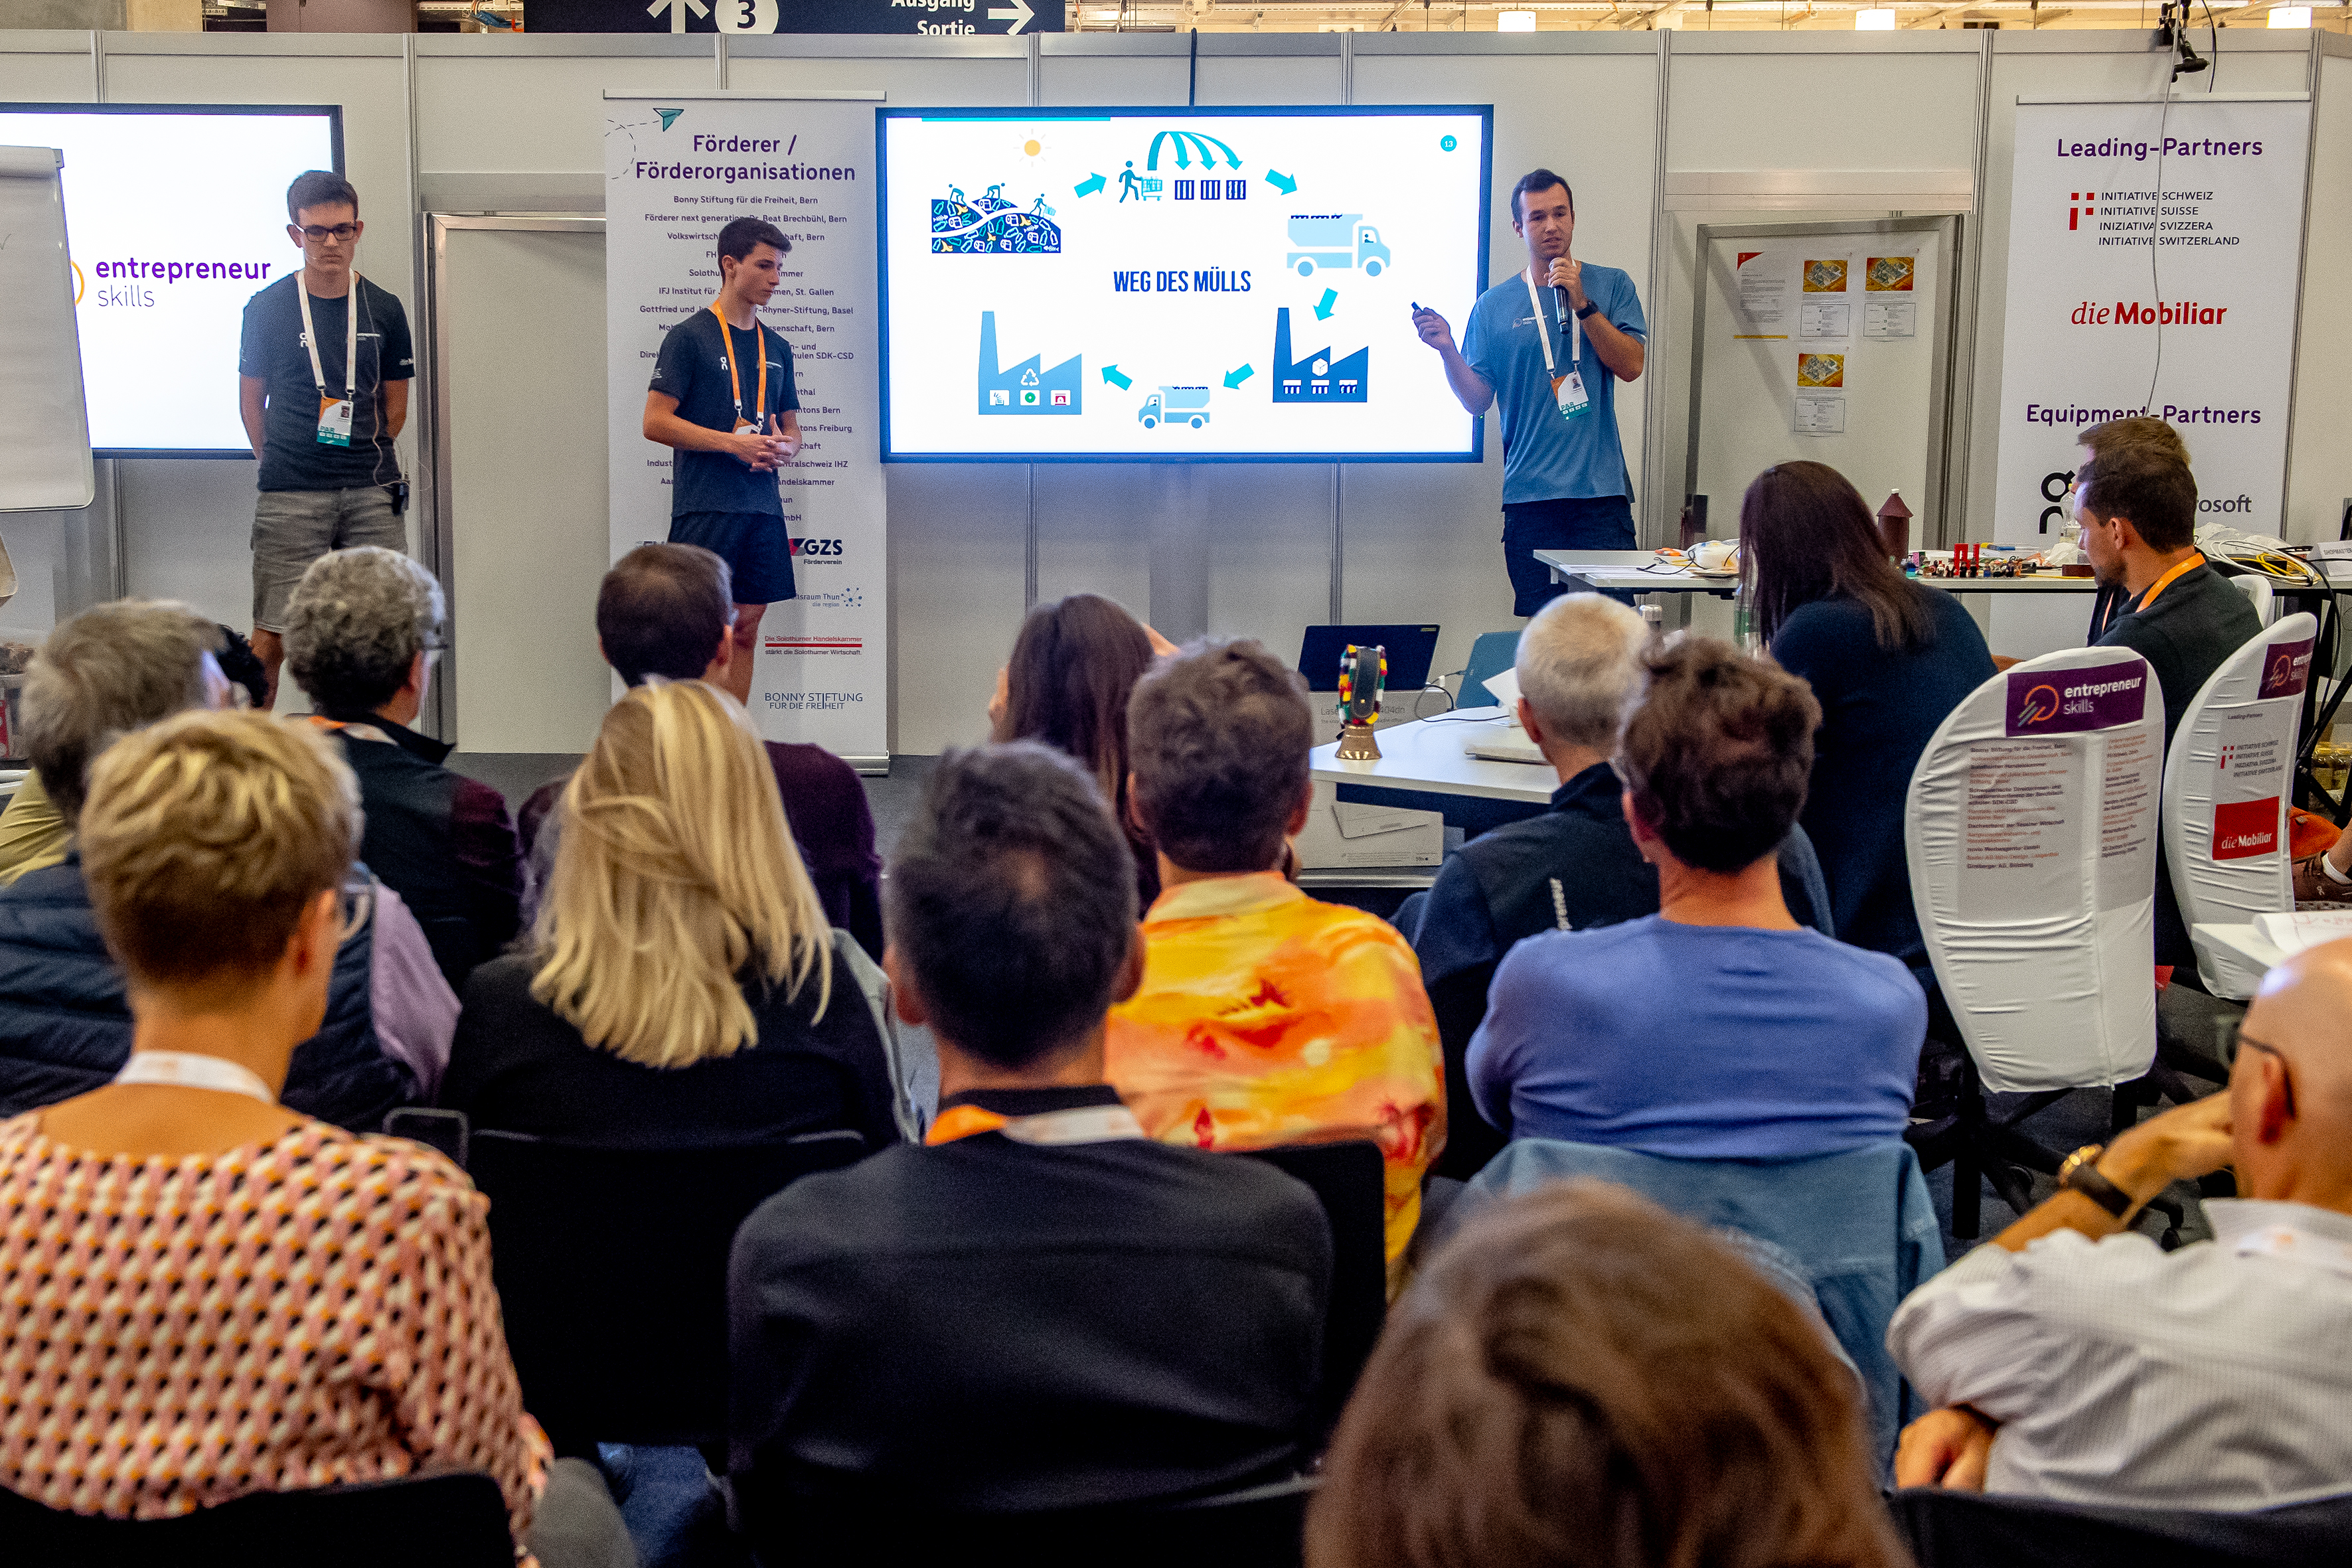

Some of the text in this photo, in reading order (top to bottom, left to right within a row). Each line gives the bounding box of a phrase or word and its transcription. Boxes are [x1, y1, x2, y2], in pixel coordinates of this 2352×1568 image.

[892, 0, 975, 12] Ausgang
[736, 1, 757, 29] 3
[917, 20, 976, 35] Sortie
[694, 134, 797, 156] Förderer /
[2057, 137, 2263, 161] Leading-Partners
[636, 161, 856, 185] Förderorganisationen
[673, 196, 698, 205] Bonny
[700, 196, 734, 205] Stiftung
[764, 196, 798, 205] Freiheit,
[2101, 192, 2214, 200] INITIATIVE SCHWEIZ
[783, 214, 827, 224] Brechbühl,
[2100, 206, 2199, 216] INITIATIVE SUISSE
[2099, 222, 2214, 230] INIZIATIVA SVIZZERA
[2098, 236, 2240, 246] INITIATIVE SWITZERLAND
[95, 257, 272, 284] entrepreneur
[1113, 266, 1251, 293] WEG DES MÜLLS
[98, 285, 155, 308] skills
[755, 307, 830, 315] r-Rhyner-Stiftung,
[2071, 301, 2228, 325] die Mobiliar
[2027, 404, 2262, 427] Equipment-Partners
[2197, 494, 2252, 513] osoft
[804, 539, 843, 556] GZS
[2064, 676, 2142, 698] entrepreneur
[765, 692, 863, 702] BONNY STIFTUNG
[2063, 699, 2094, 714] skills
[2221, 832, 2272, 849] die Mobiliar
